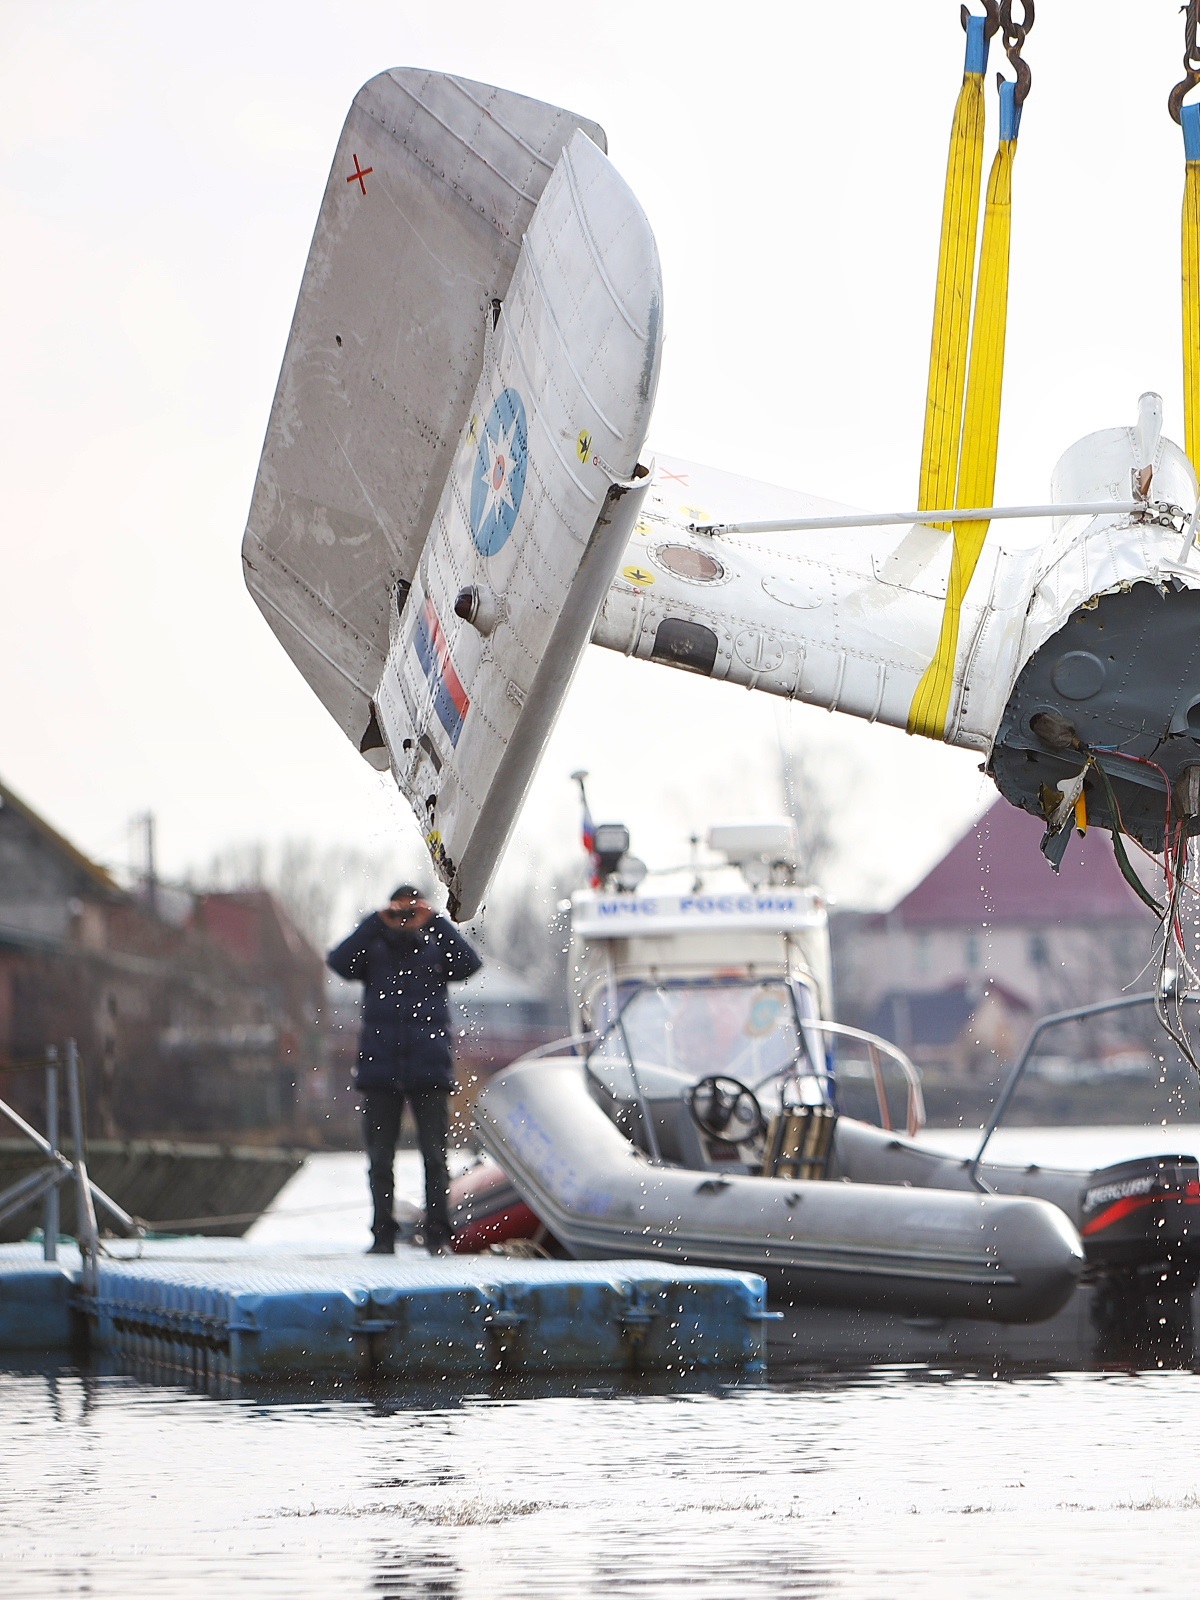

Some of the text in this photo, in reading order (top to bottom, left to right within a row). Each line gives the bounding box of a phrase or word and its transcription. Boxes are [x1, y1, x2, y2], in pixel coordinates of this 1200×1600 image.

[599, 896, 795, 917] МЧС РОССИИ
[1083, 1176, 1155, 1213] MERCURY
